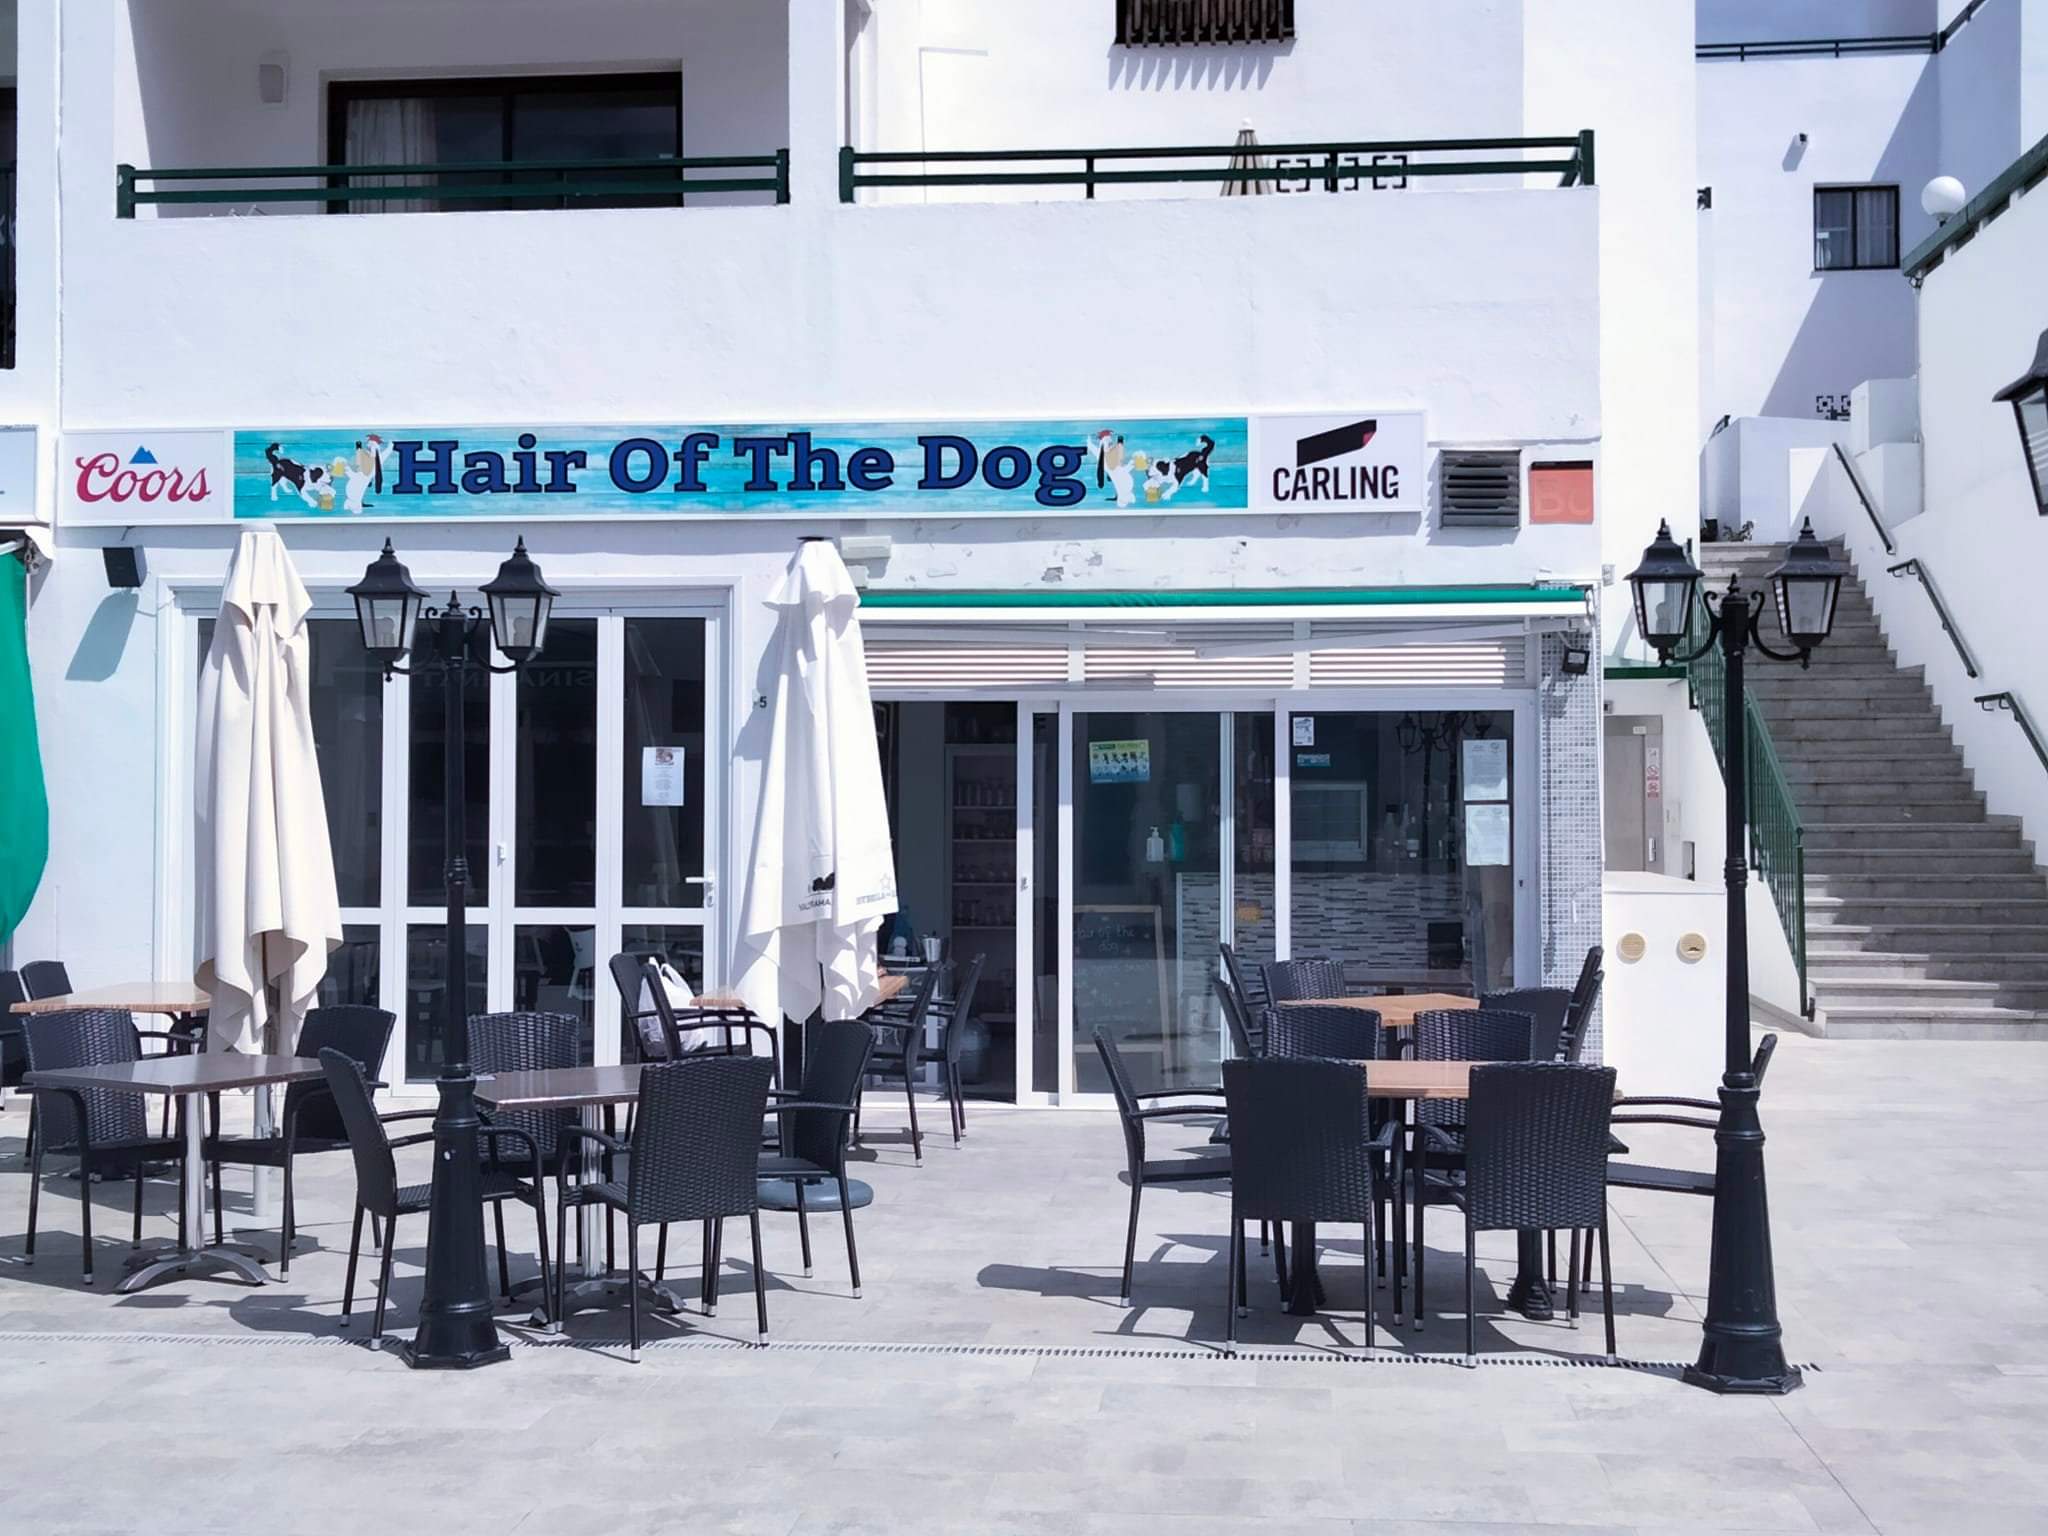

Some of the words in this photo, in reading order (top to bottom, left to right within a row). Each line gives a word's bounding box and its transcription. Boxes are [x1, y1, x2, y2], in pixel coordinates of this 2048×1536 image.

[75, 453, 212, 502] Coors
[392, 432, 588, 495] Hair
[608, 432, 720, 494] Of
[733, 431, 895, 492] The
[917, 435, 1089, 507] Dog
[1272, 465, 1399, 502] CARLING
